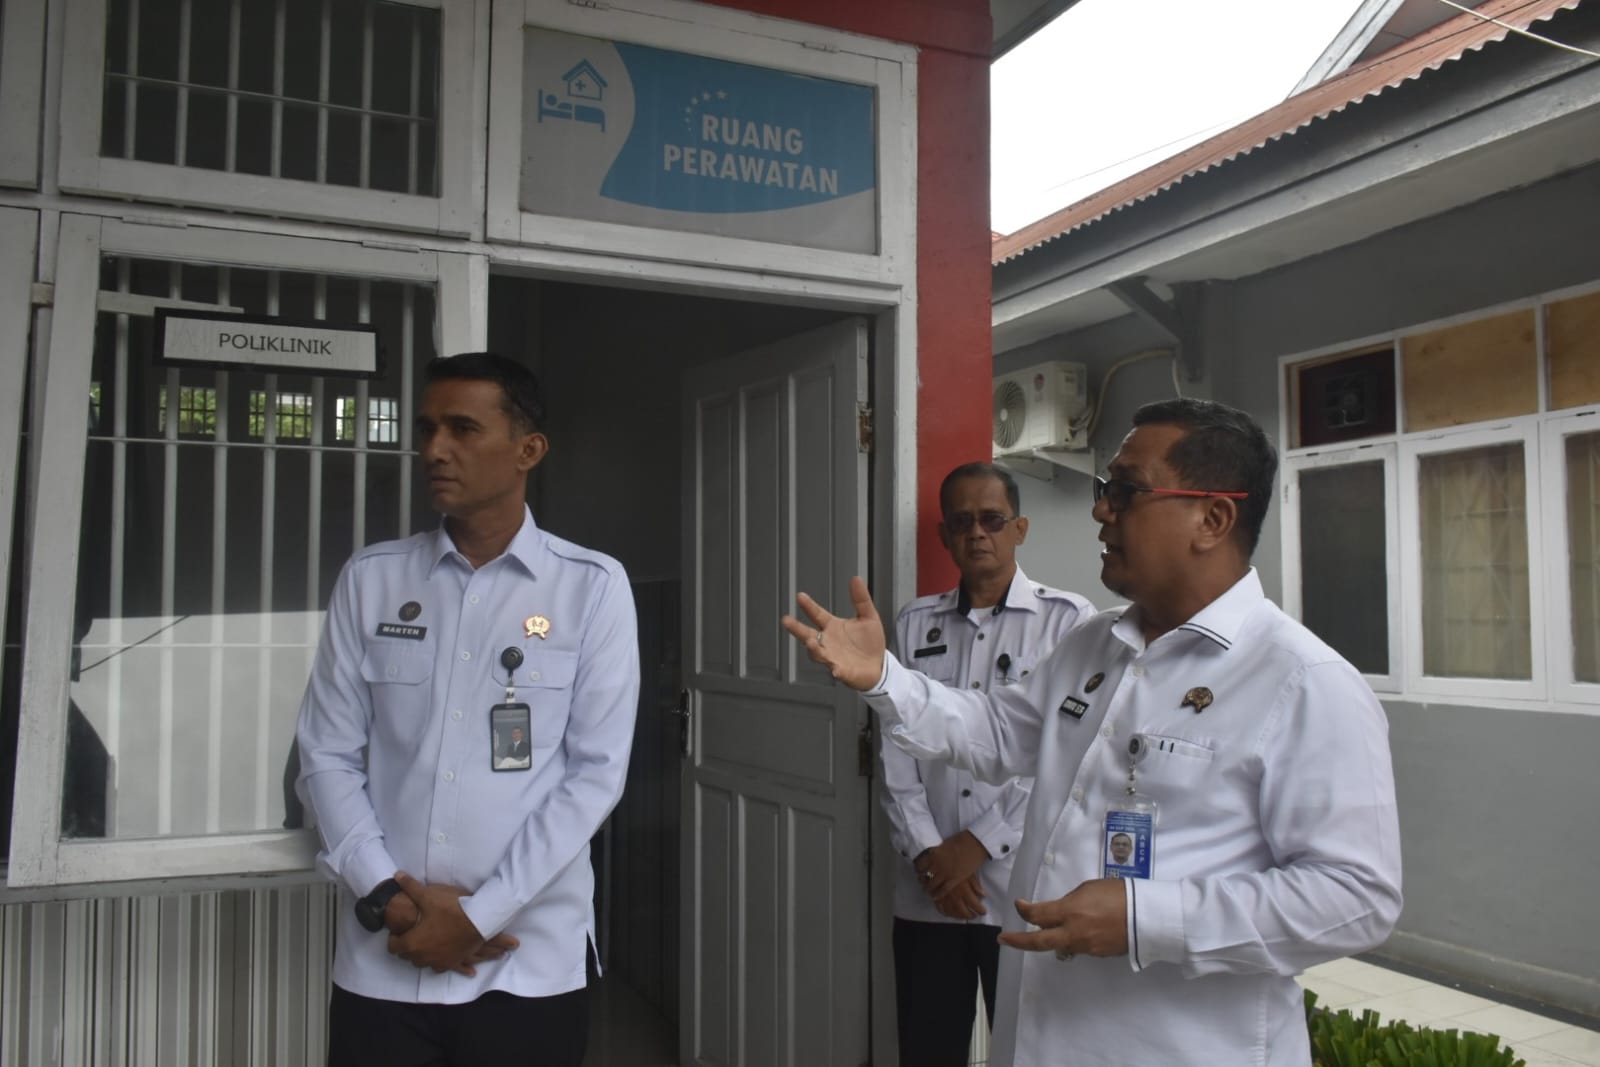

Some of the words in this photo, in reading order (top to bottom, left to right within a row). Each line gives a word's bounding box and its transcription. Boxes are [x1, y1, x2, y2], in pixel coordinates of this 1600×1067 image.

[702, 114, 803, 155] RUANG
[663, 144, 838, 195] PERAWATAN
[219, 333, 332, 355] POLIKLINIK
